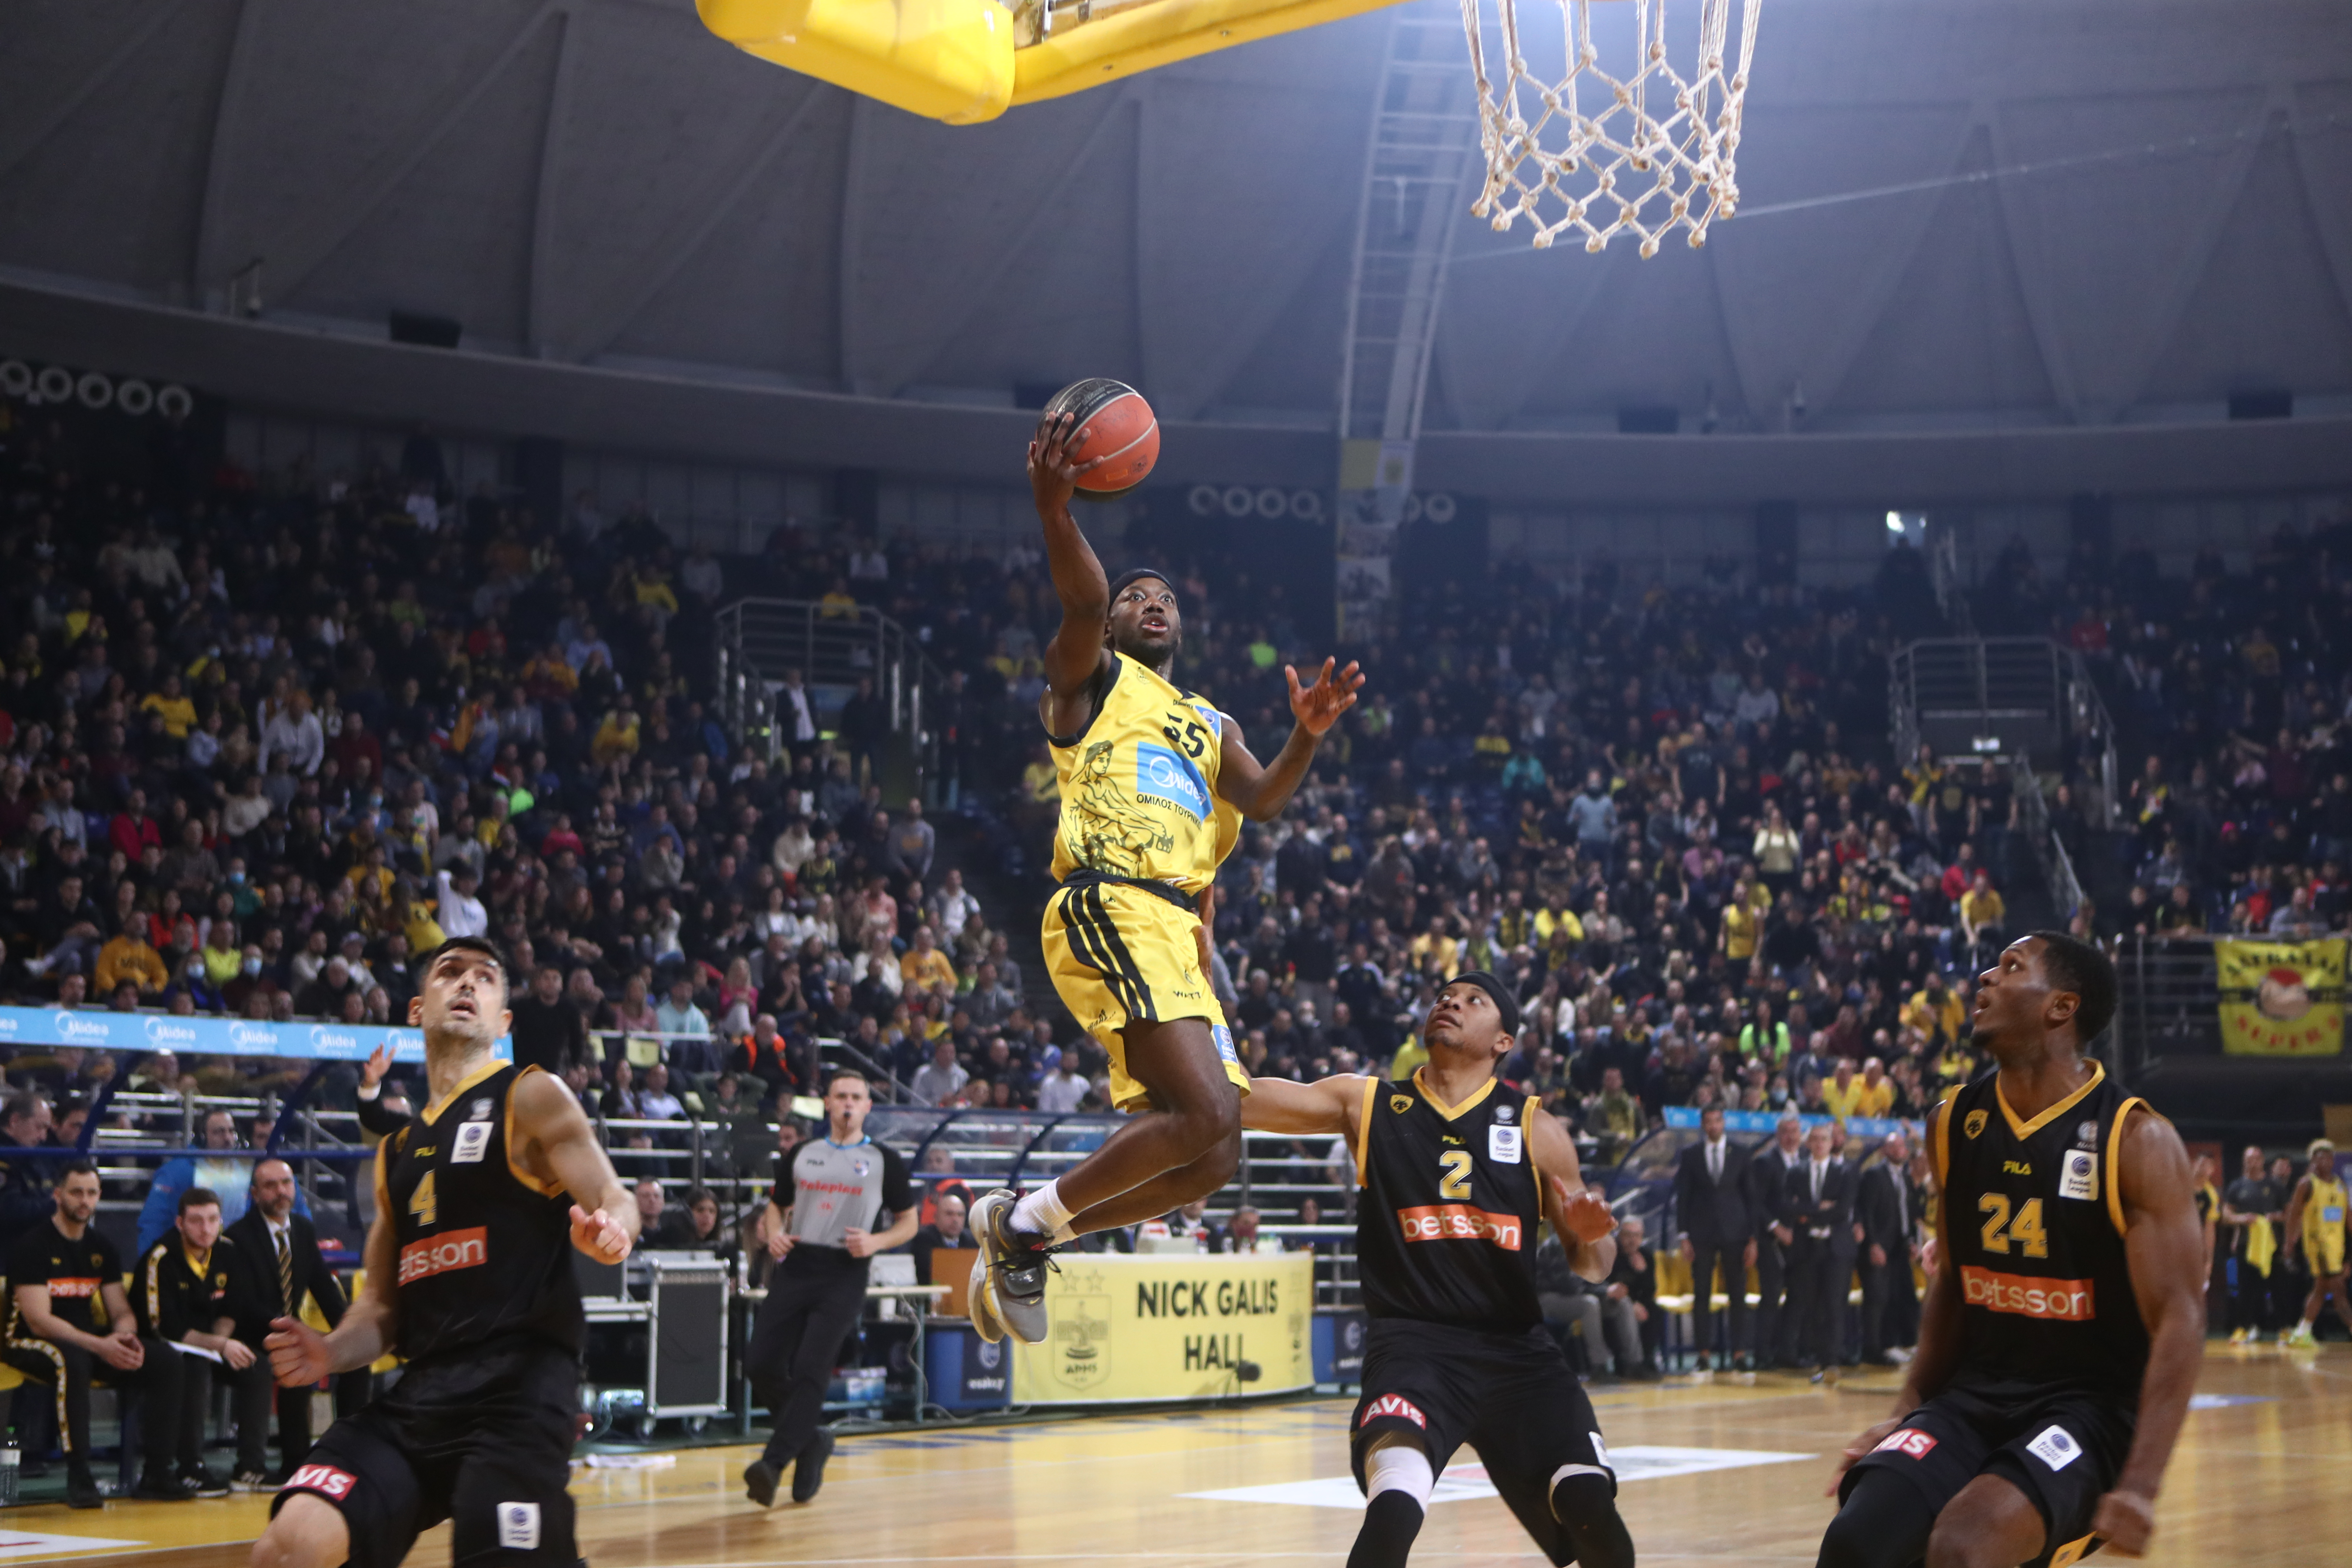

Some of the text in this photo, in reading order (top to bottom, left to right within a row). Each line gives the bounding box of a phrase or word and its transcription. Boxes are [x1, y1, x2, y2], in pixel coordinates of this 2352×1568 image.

[1161, 770, 1207, 806] Midea
[1136, 794, 1172, 810] ΟΜΙΛΟΣ
[68, 1020, 109, 1035] Midea
[156, 1026, 196, 1041] Midea
[239, 1031, 278, 1044] Midea
[321, 1035, 356, 1048] Midea
[397, 1038, 425, 1050] Mide
[1439, 1150, 1473, 1200] 2
[2003, 1160, 2032, 1175] FILA
[408, 1169, 438, 1227] 4
[1401, 1210, 1519, 1246] betsson
[1978, 1192, 2048, 1259] 24
[1137, 1278, 1278, 1317] NICK GALIS
[1364, 1396, 1423, 1426] AVIS
